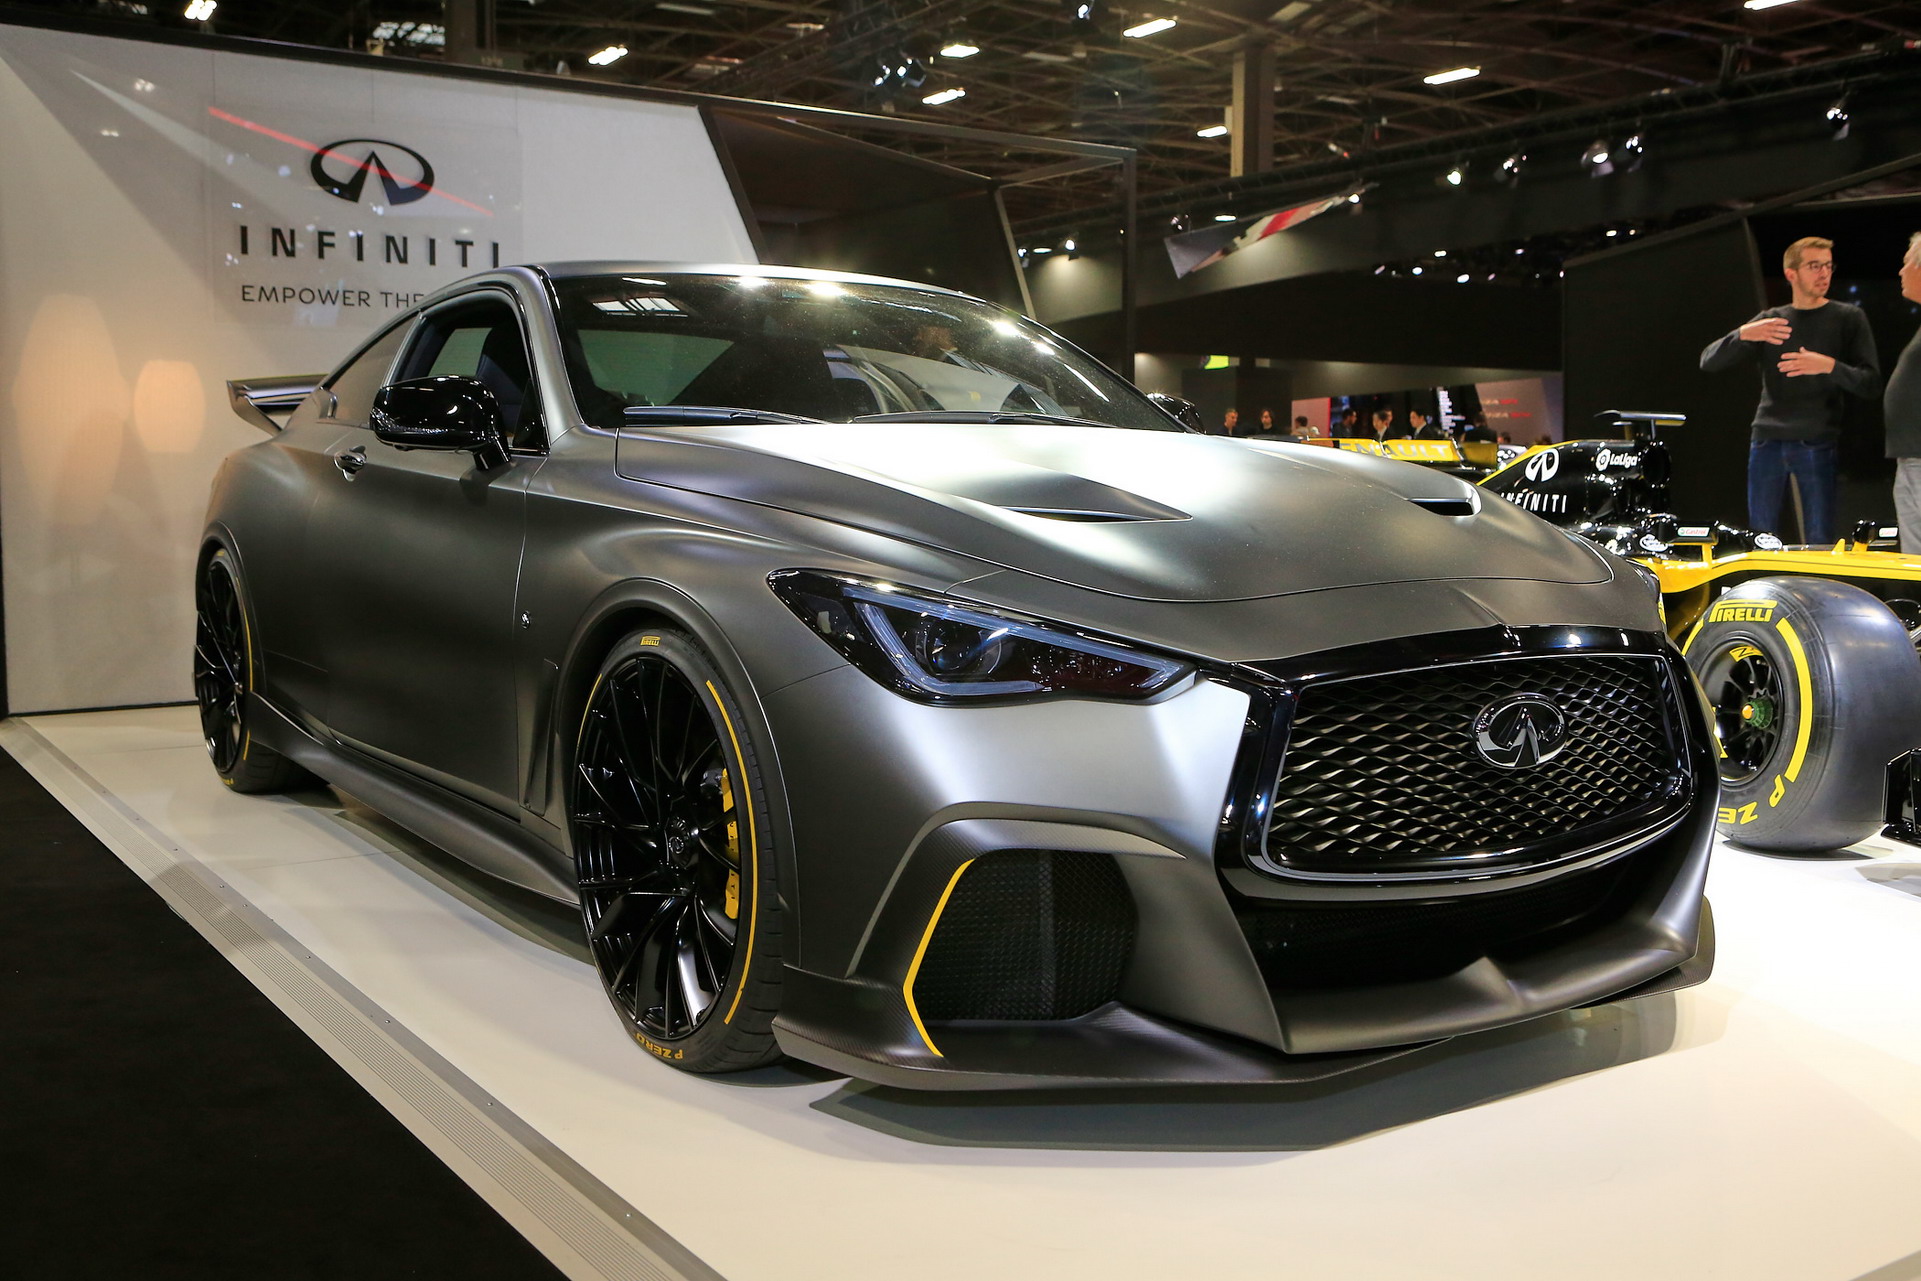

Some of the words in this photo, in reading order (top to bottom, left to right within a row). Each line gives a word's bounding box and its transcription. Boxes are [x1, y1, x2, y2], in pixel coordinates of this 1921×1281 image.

[239, 225, 499, 268] INFINITI
[242, 285, 371, 307] EMPOWER
[1709, 599, 1778, 622] PIRELLI
[1769, 774, 1785, 808] P
[1718, 801, 1758, 824] ZE
[635, 1032, 672, 1058] ZERO
[674, 1049, 684, 1059] P
